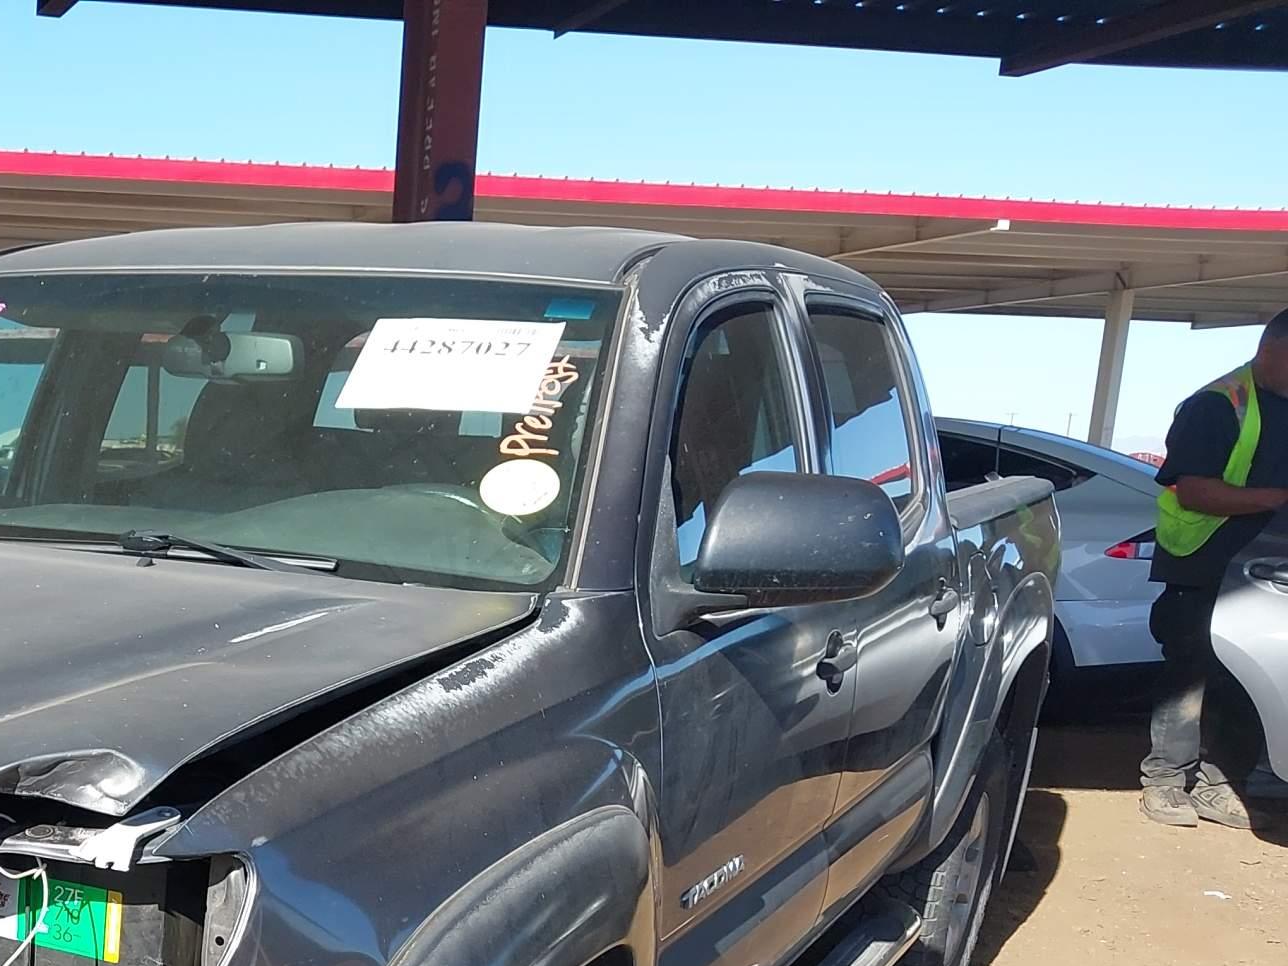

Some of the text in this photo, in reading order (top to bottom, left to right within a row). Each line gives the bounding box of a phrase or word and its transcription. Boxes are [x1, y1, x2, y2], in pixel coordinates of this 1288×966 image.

[383, 338, 533, 358] 44287027
[679, 854, 745, 910] TACOMA
[53, 884, 86, 906] 27F
